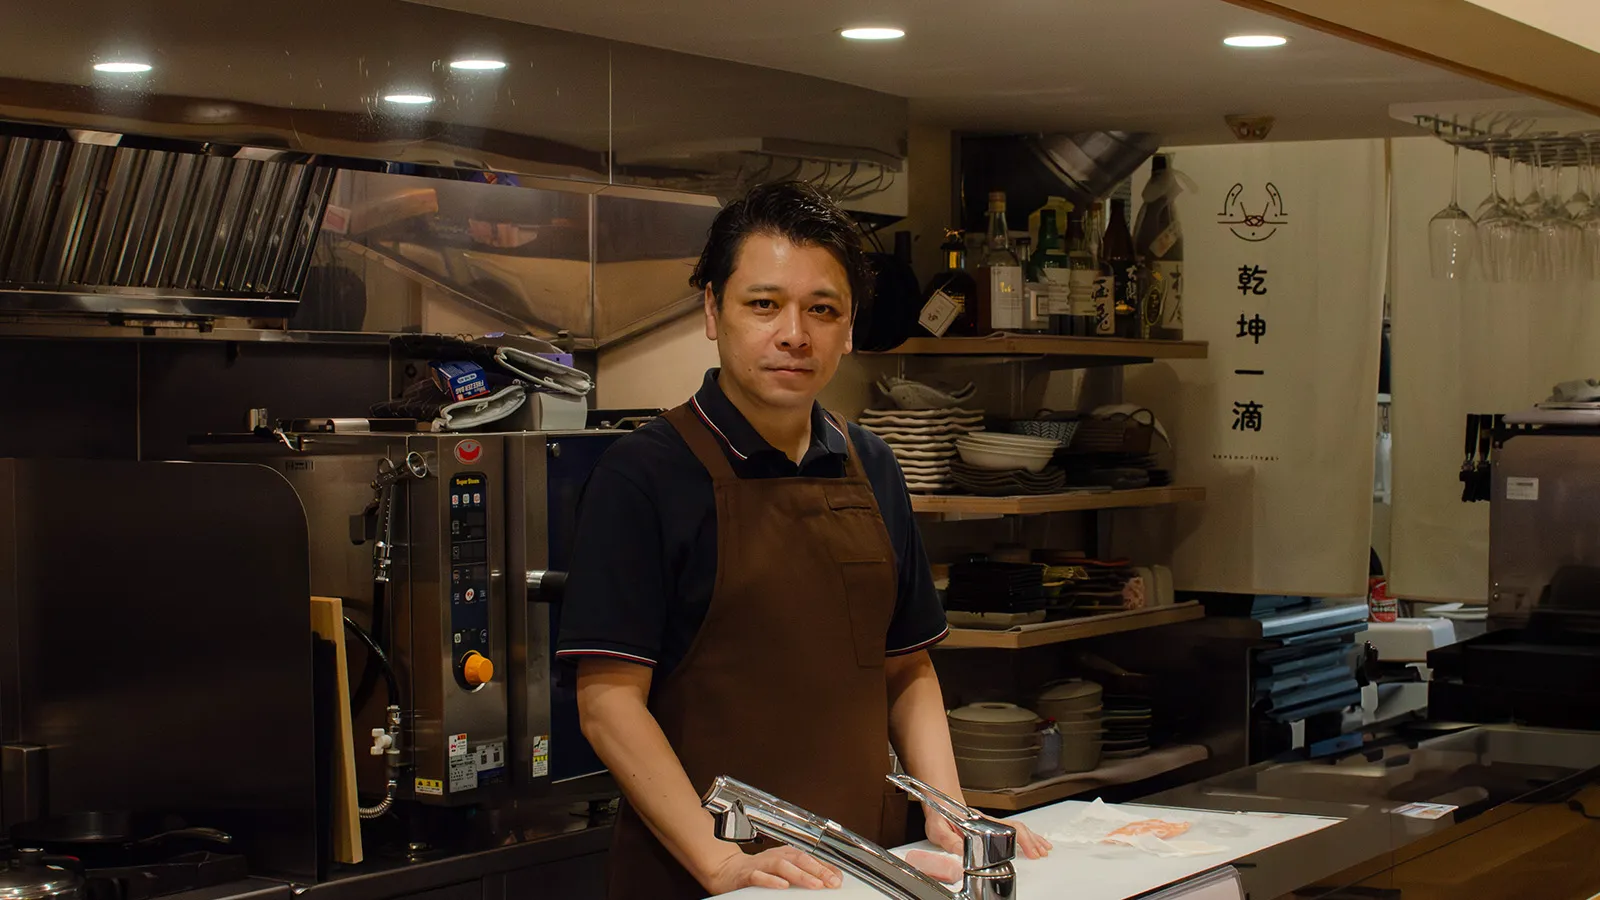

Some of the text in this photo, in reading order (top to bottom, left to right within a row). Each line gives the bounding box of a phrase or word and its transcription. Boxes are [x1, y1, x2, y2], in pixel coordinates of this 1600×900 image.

[1231, 264, 1268, 432] 乾坤一滴
[455, 386, 465, 395] BAG
[465, 379, 485, 392] FREEZER
